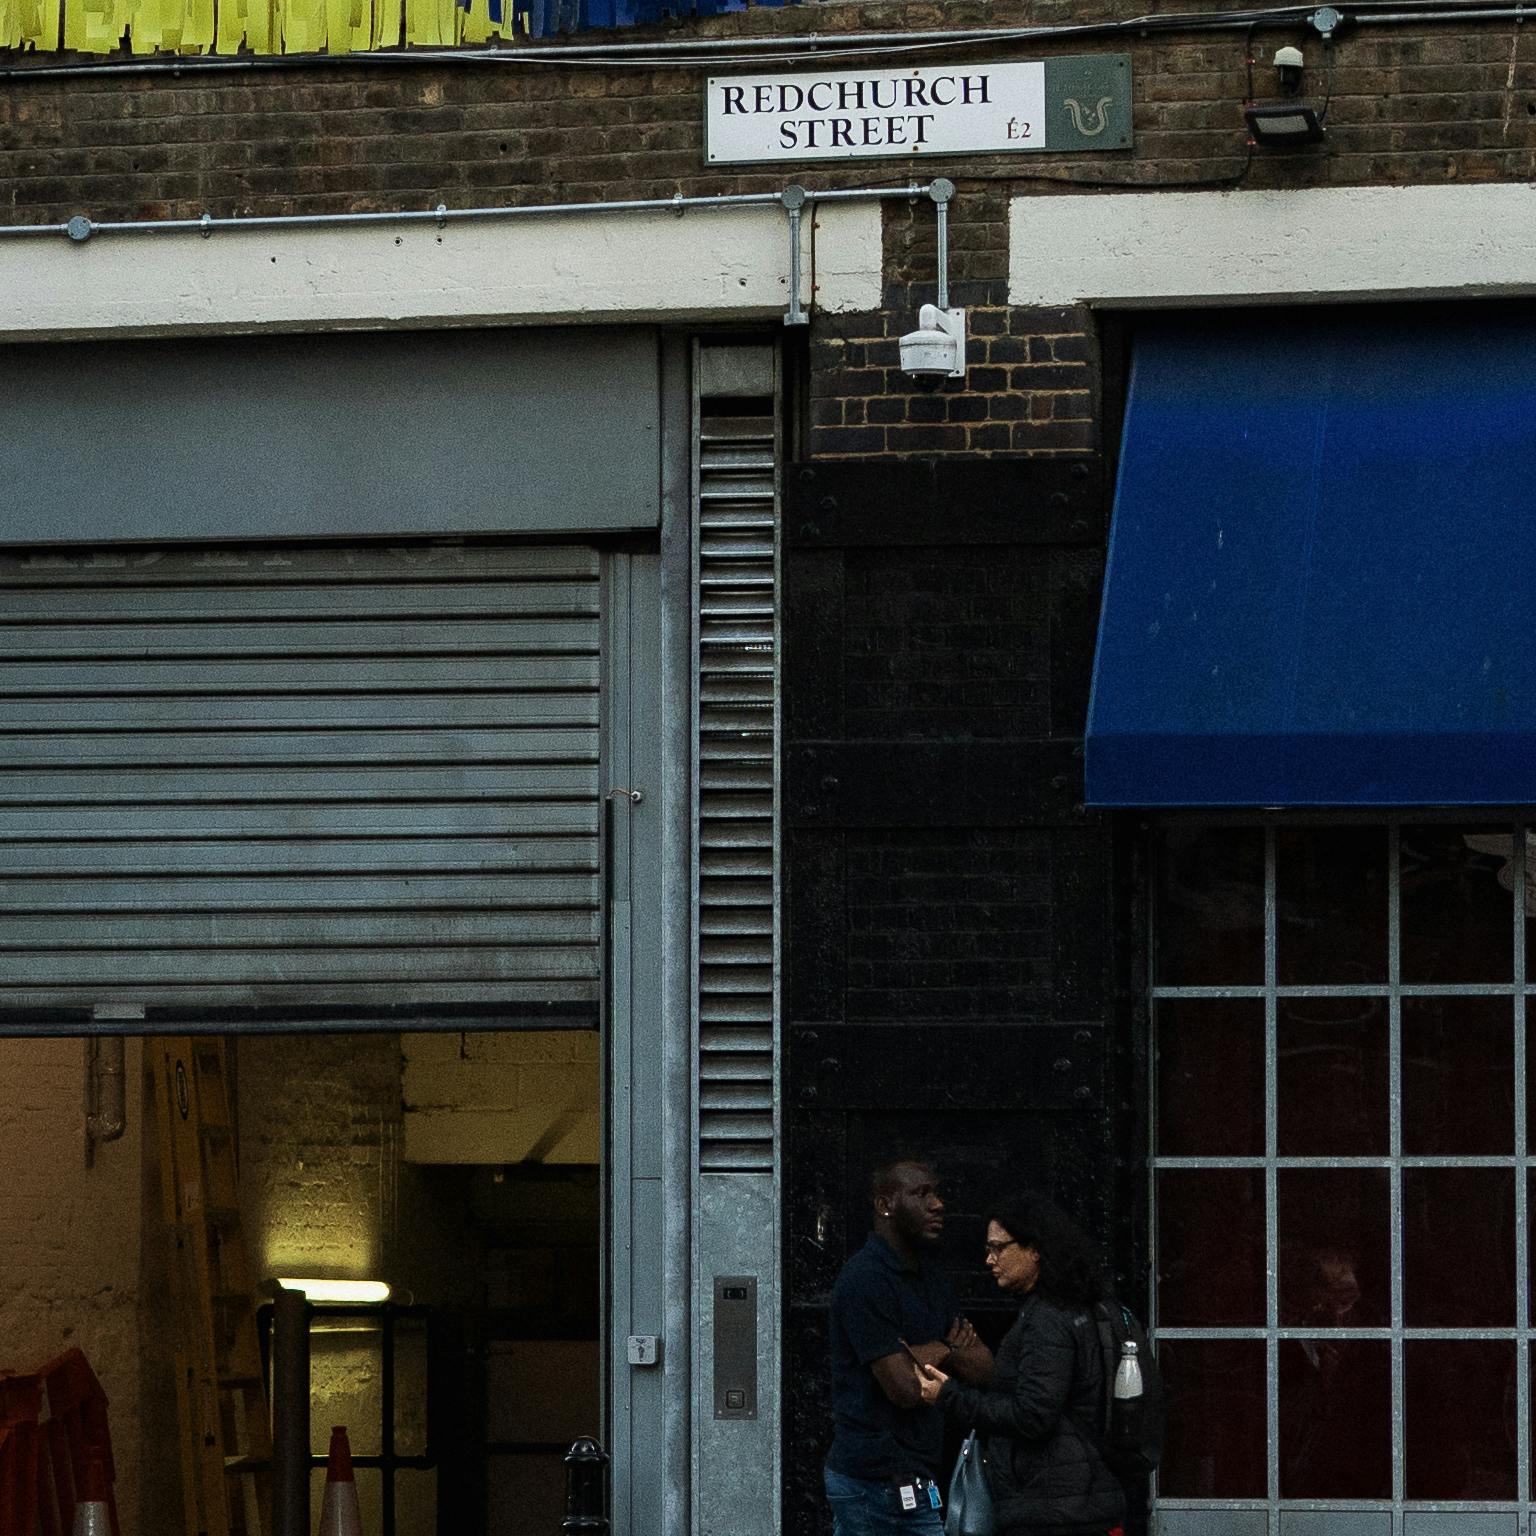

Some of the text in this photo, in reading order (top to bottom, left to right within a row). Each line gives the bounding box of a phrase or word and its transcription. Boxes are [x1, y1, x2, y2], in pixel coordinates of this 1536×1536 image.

[721, 75, 992, 115] REDCHURCH
[779, 114, 935, 149] STREET
[1006, 119, 1032, 140] E2
